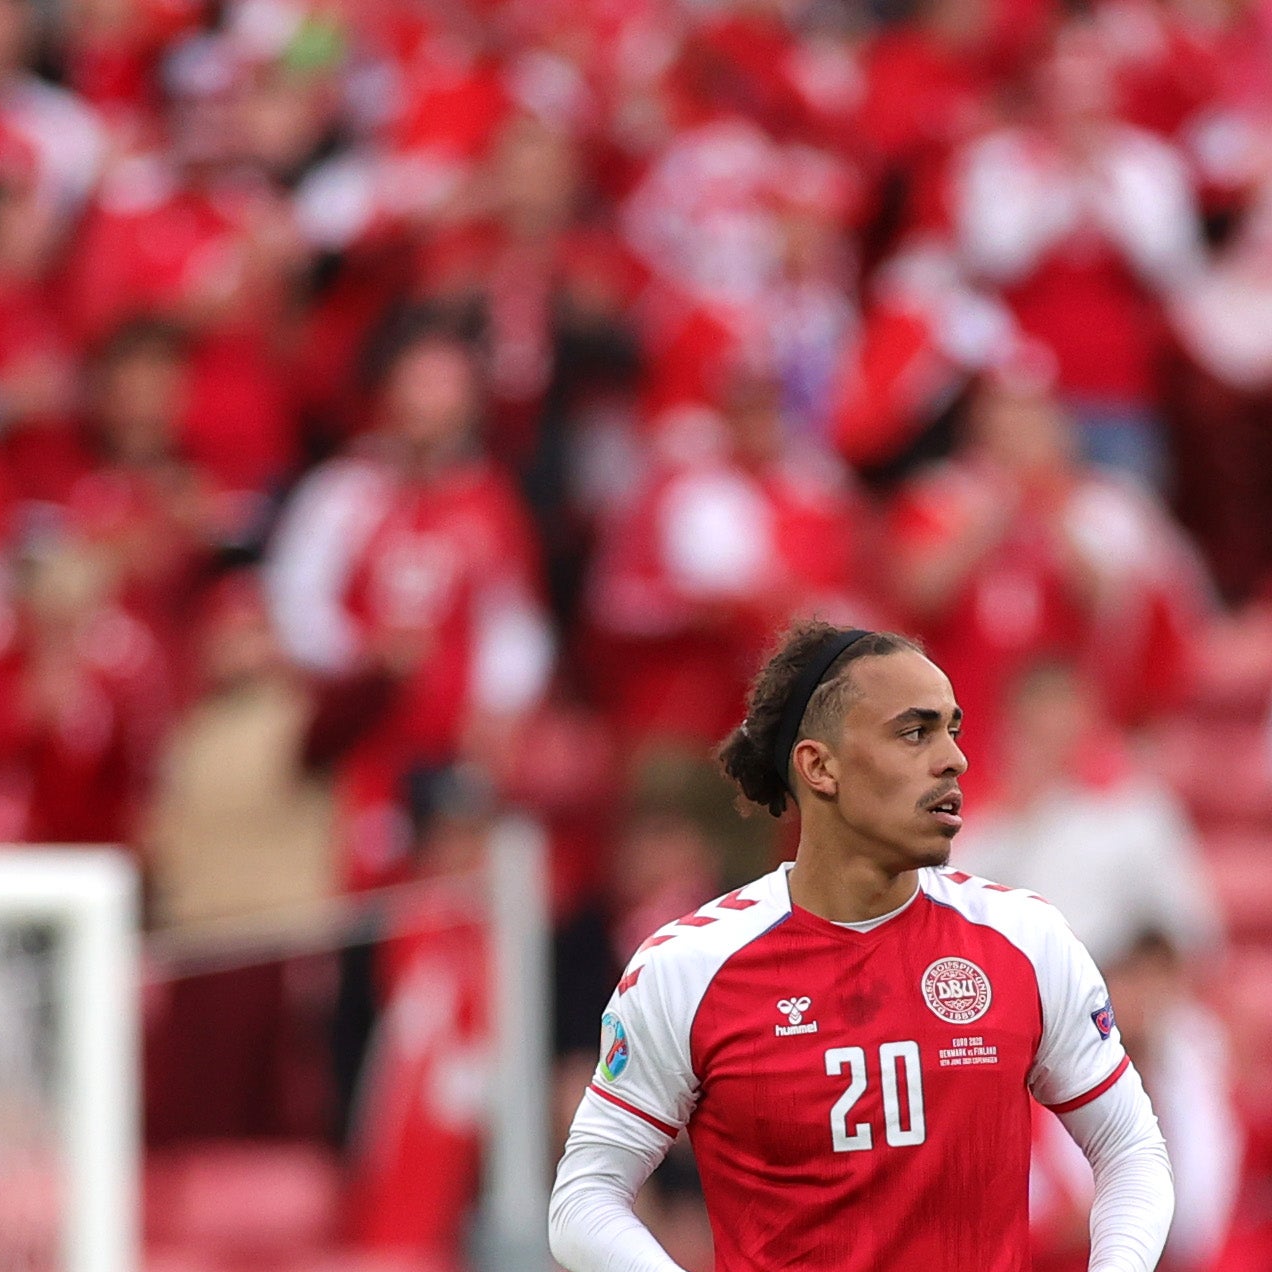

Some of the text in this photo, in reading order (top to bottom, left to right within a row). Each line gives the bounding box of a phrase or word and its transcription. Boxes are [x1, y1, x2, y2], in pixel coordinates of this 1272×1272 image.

[936, 980, 977, 1000] DBU
[775, 1020, 818, 1037] hummel
[825, 1040, 926, 1152] 20
